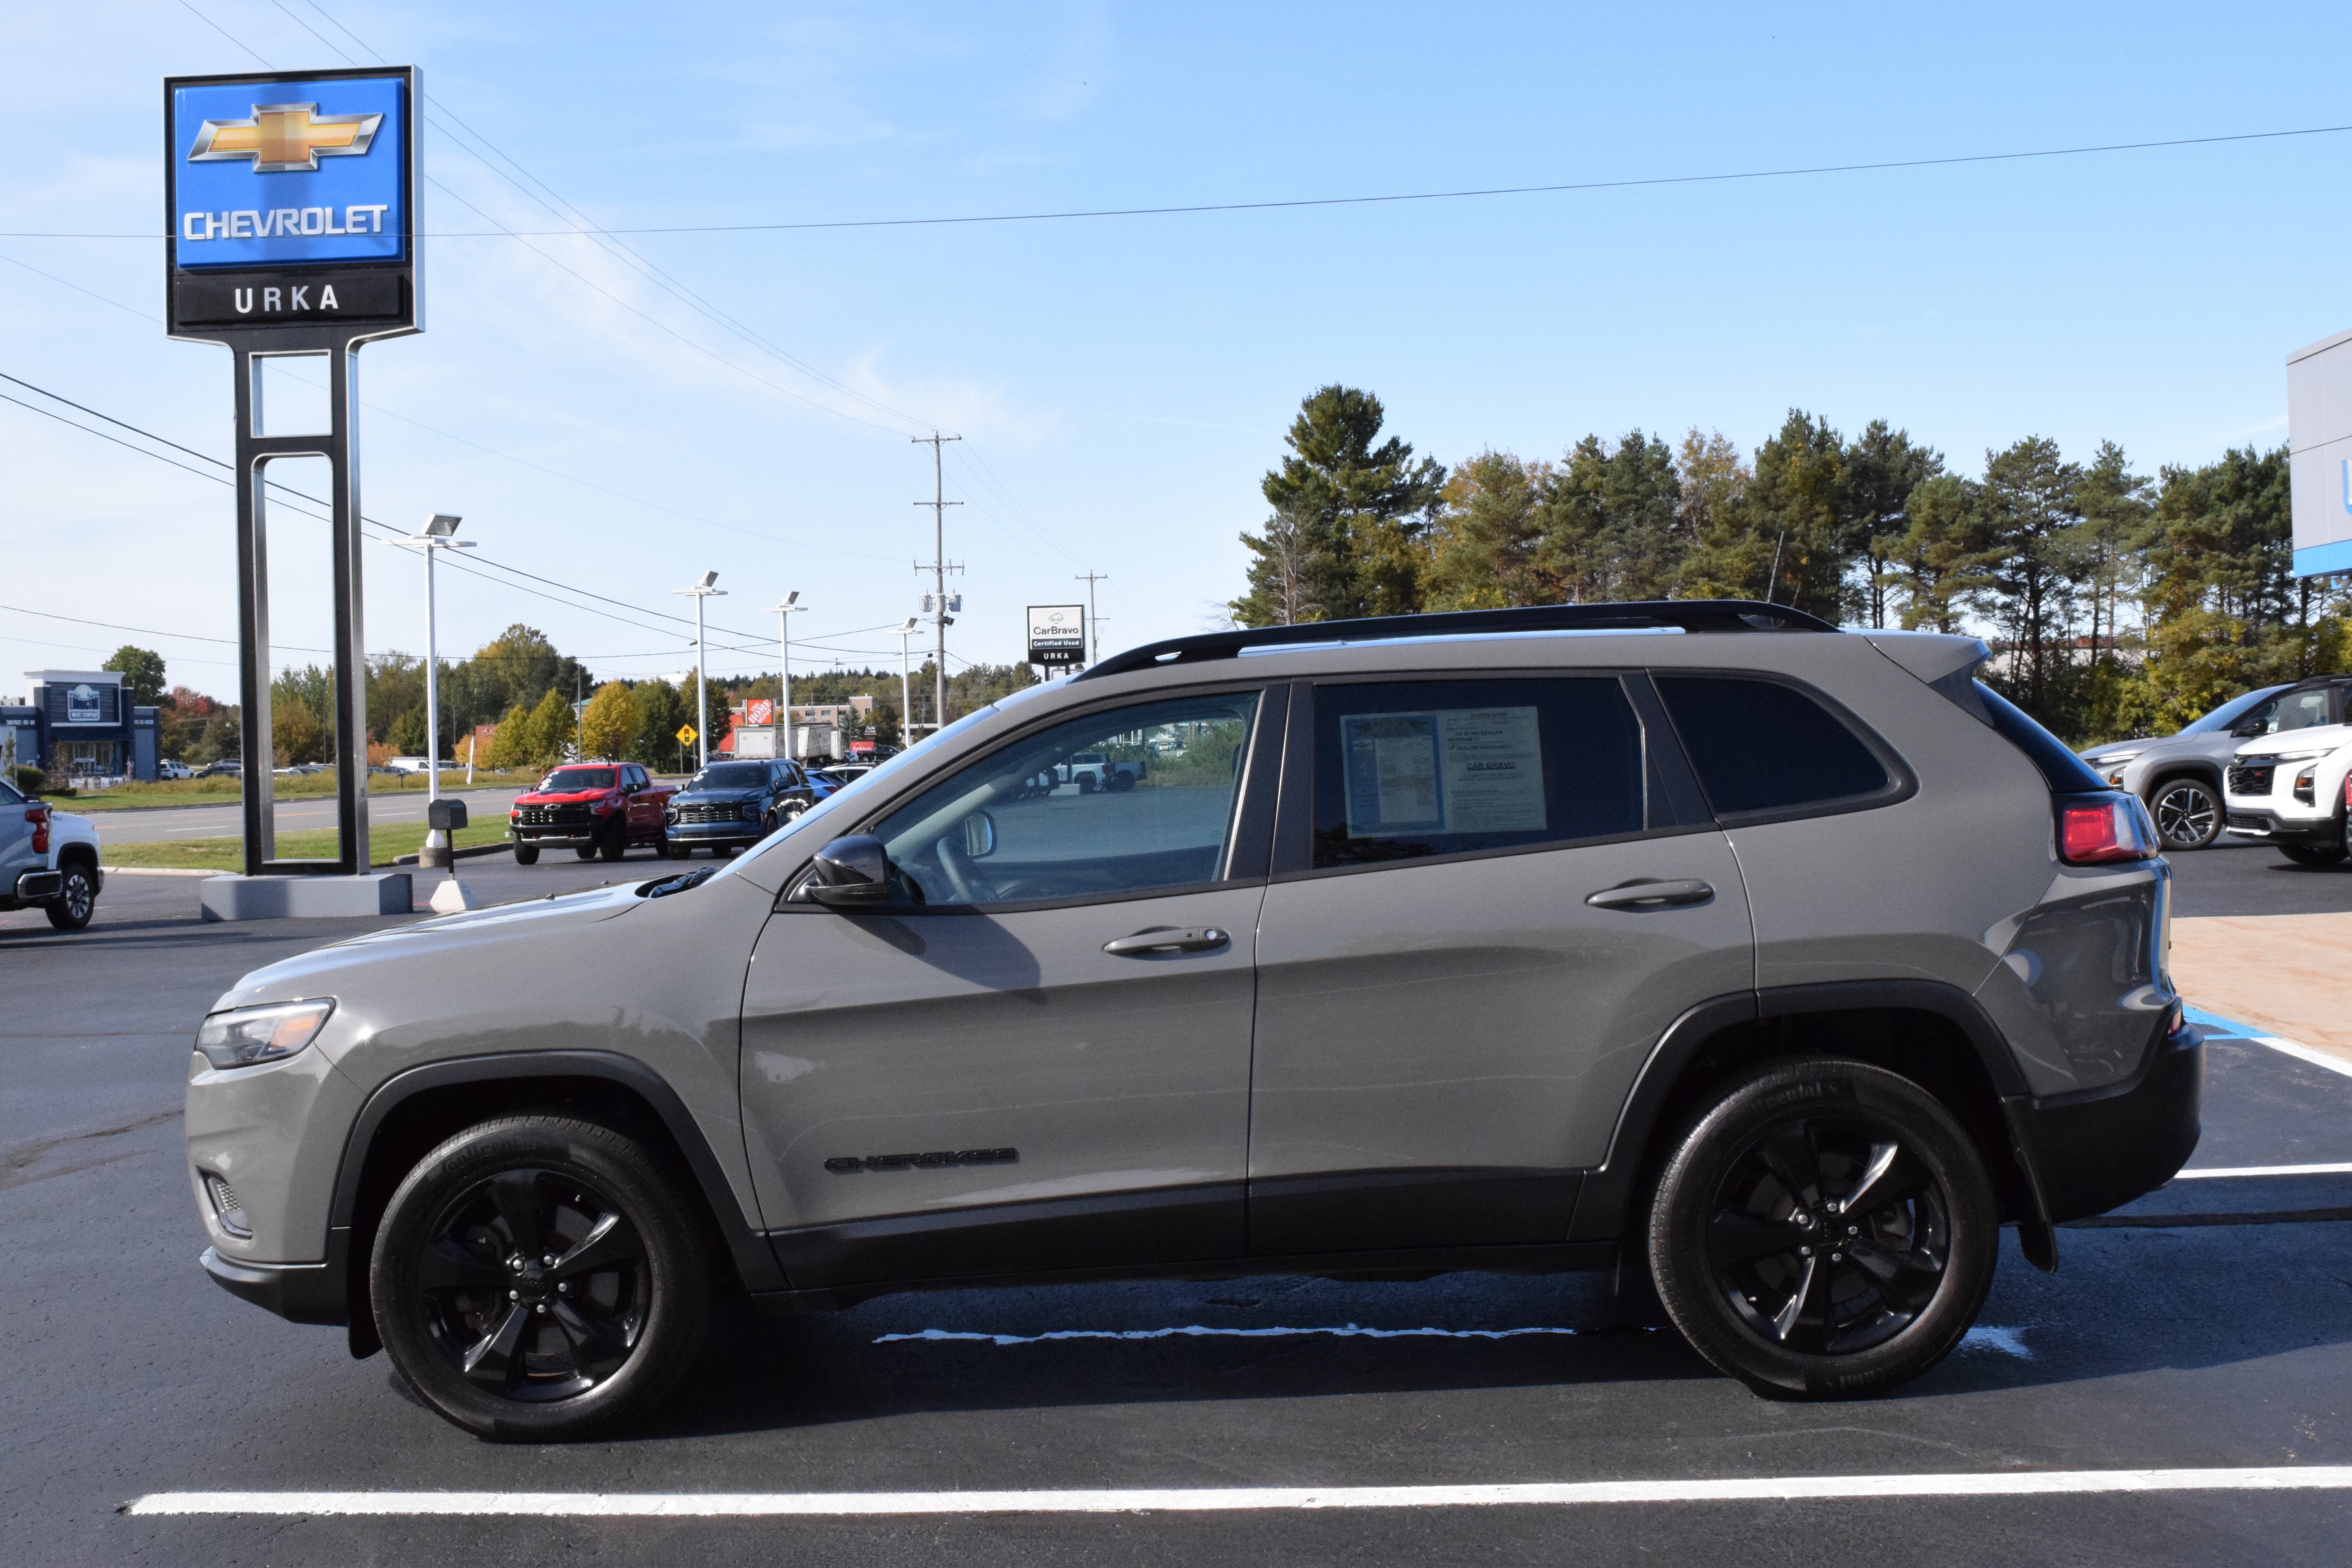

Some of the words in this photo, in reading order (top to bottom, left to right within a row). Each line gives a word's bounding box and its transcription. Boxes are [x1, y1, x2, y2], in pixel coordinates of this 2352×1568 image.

[184, 205, 388, 240] CHEVROLET
[235, 285, 339, 314] URKA
[1033, 626, 1078, 635] CarBravo
[748, 699, 772, 724] HOME
[750, 702, 760, 712] THE
[757, 708, 772, 724] DEPOT
